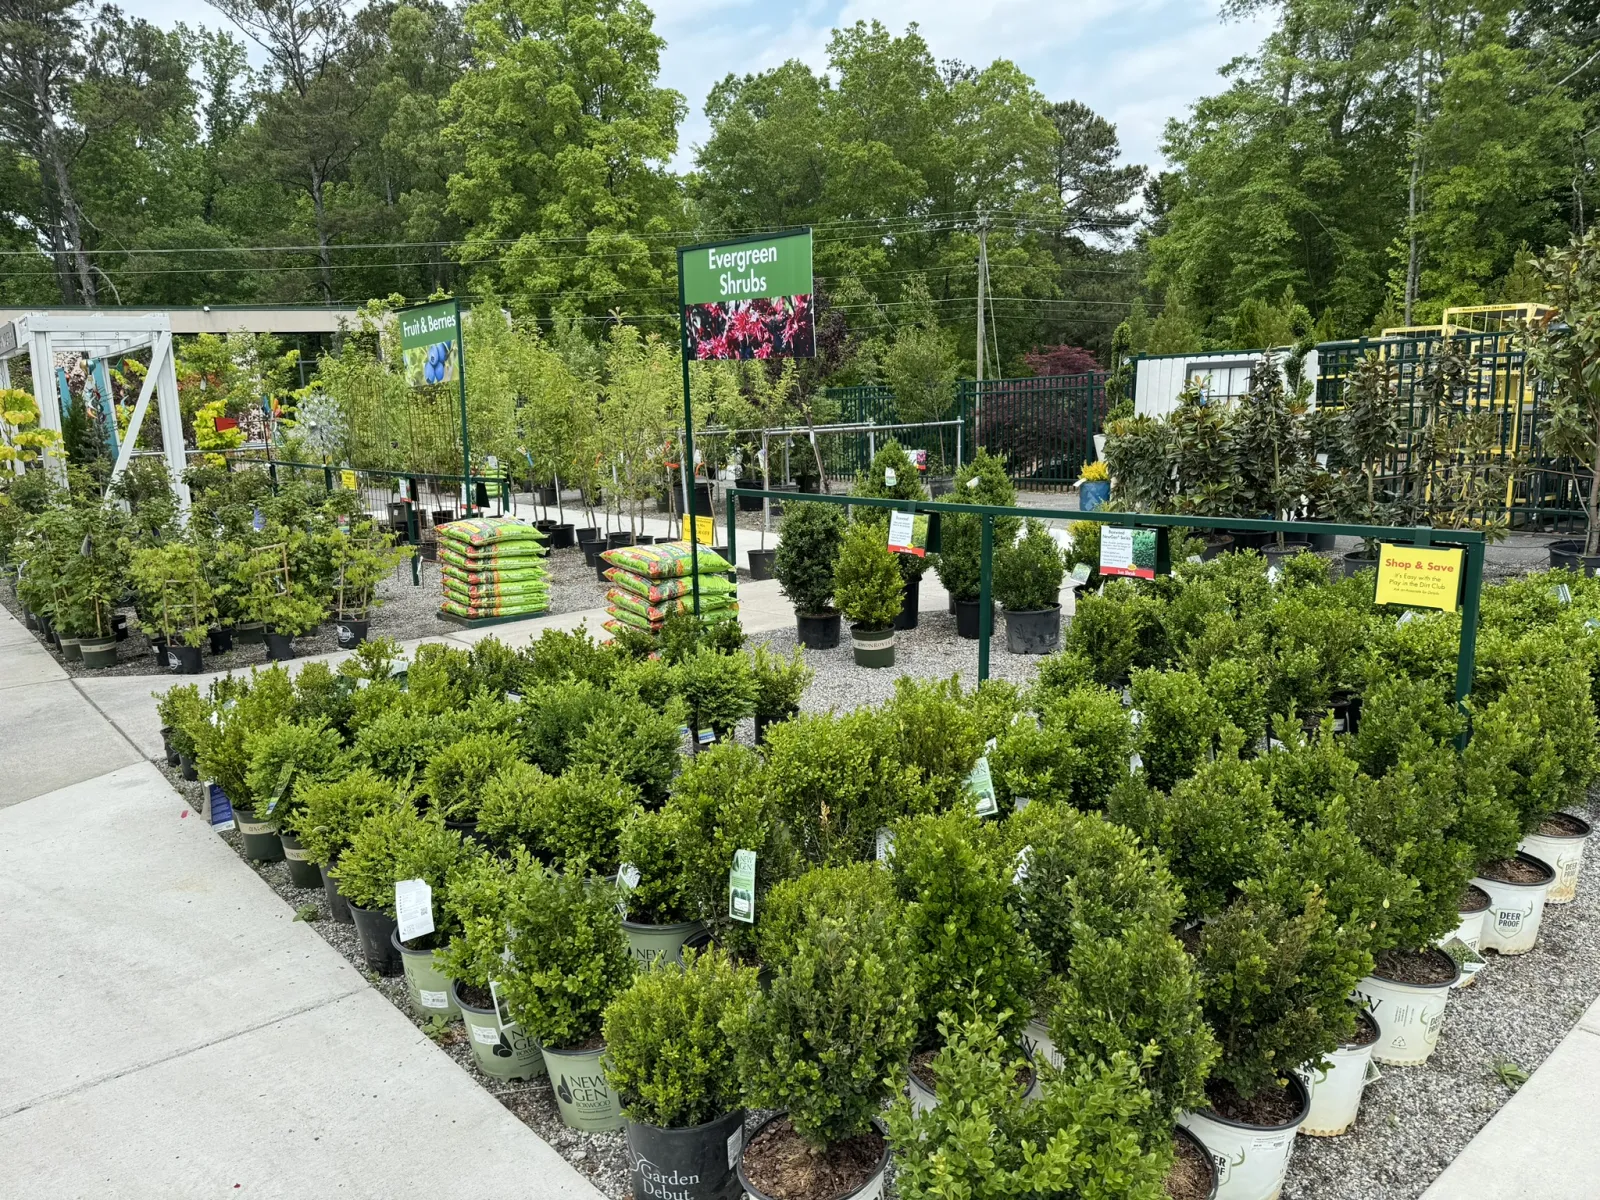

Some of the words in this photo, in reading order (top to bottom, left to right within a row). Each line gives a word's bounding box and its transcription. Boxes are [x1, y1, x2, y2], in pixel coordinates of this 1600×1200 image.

[708, 246, 777, 272] Evergreen
[719, 269, 767, 295] Shrubs
[403, 319, 420, 338] Fruit
[420, 316, 428, 334] &
[427, 311, 456, 332] Berries
[1385, 558, 1412, 570] Shop
[1414, 561, 1423, 570] &
[1427, 562, 1454, 573] Save
[1404, 573, 1417, 581] Easy
[1388, 578, 1401, 586] Play
[1431, 582, 1446, 590] Club
[740, 855, 753, 863] NEW
[740, 862, 752, 871] GEN
[1499, 911, 1521, 921] DEER
[1498, 919, 1520, 927] PROOF
[636, 948, 668, 960] NEW
[570, 1075, 605, 1088] NEW
[573, 1087, 607, 1102] GEN
[576, 1100, 611, 1108] BOXWOOD
[1213, 1154, 1226, 1167] ER
[640, 1163, 700, 1185] Garden
